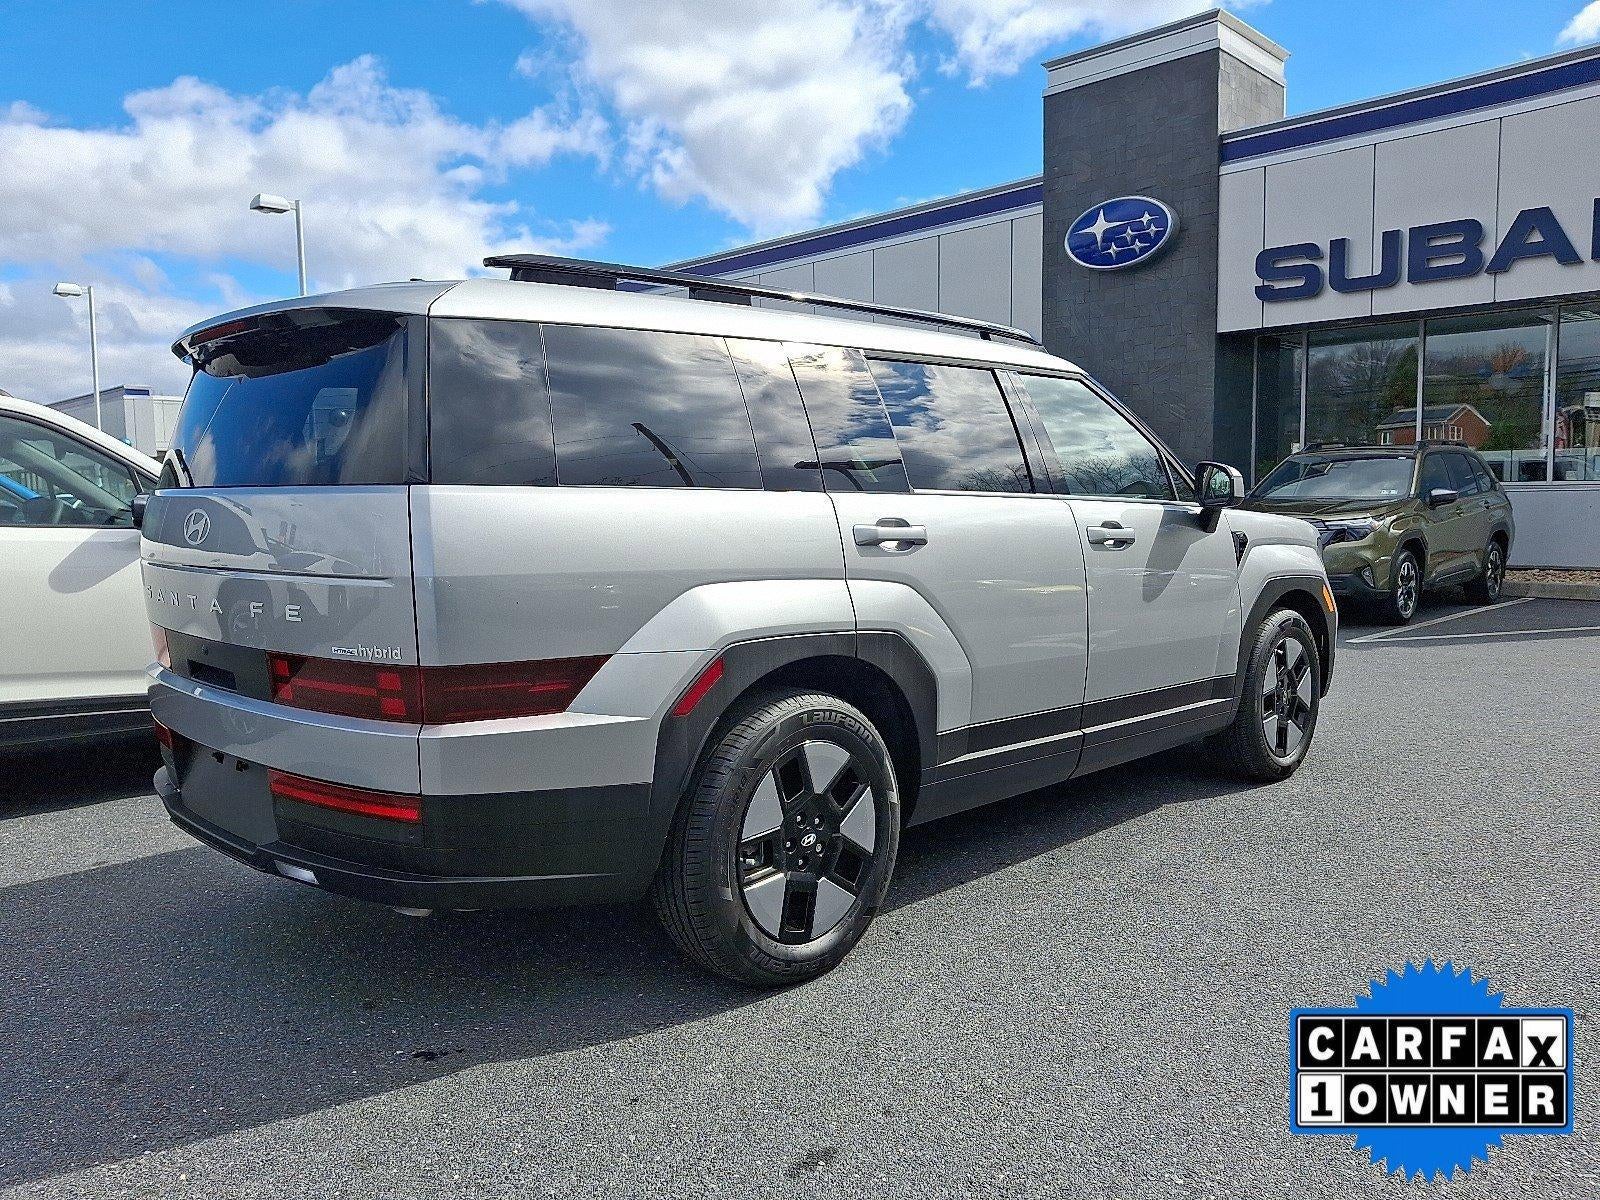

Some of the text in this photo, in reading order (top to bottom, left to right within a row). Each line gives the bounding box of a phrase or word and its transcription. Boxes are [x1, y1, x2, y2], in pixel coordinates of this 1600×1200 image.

[1255, 198, 1600, 301] SUBA
[250, 601, 303, 622] FE
[358, 643, 403, 660] hybrid
